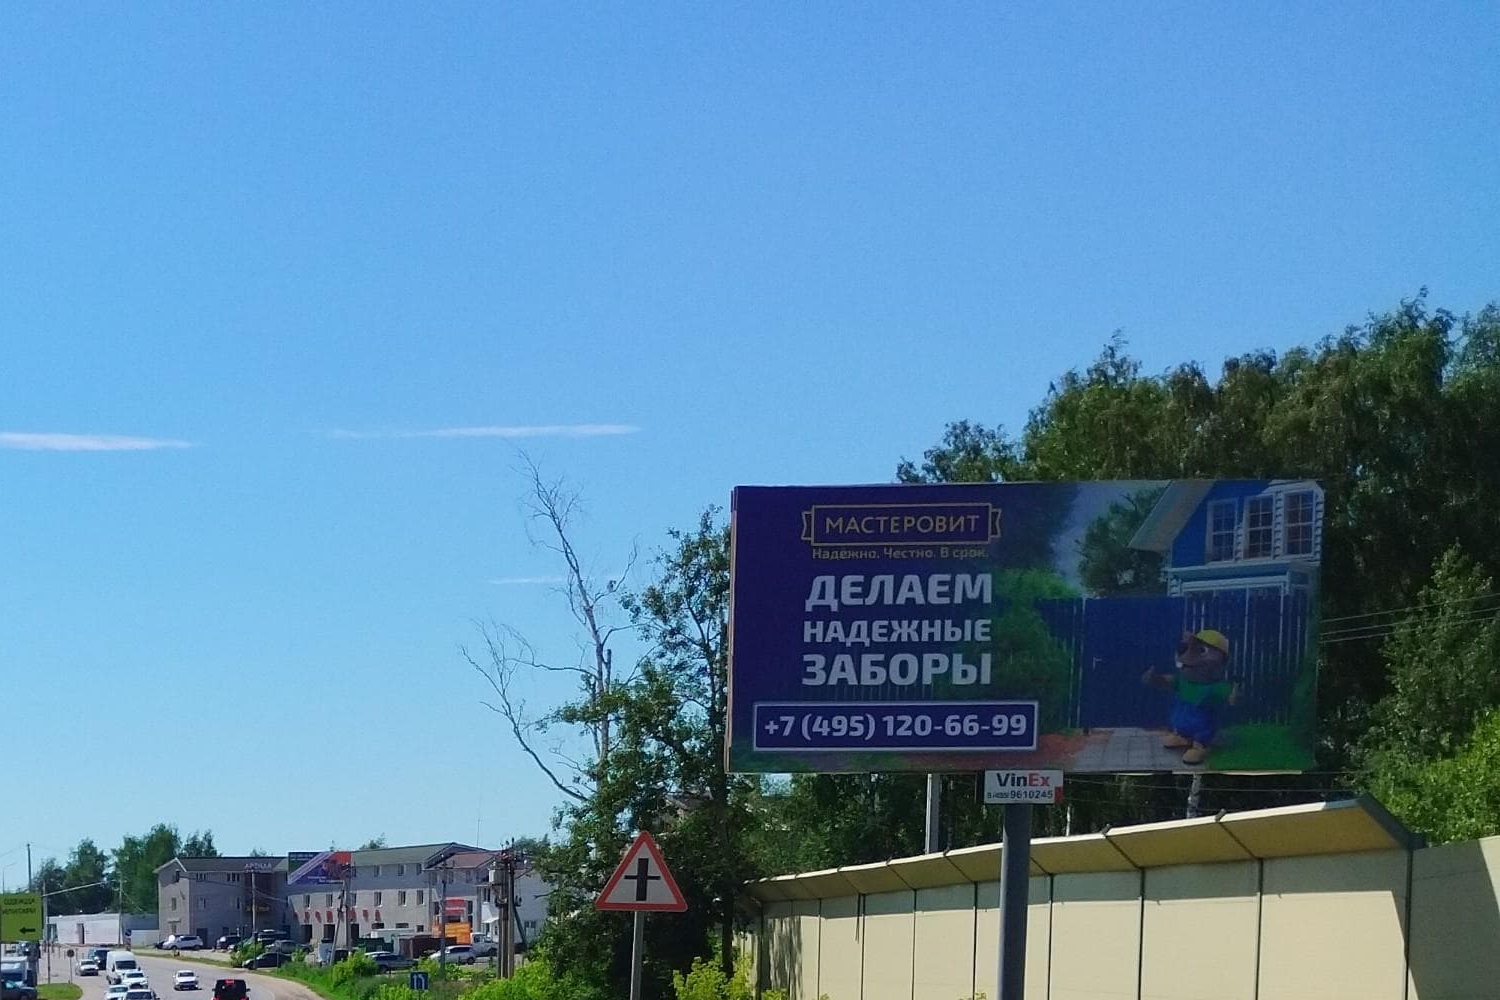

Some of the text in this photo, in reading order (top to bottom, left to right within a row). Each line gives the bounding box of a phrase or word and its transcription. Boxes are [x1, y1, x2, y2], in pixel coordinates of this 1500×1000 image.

[825, 515, 980, 534] МАСТЕРОВИТ
[883, 547, 936, 559] Честно.
[940, 547, 949, 558] В
[953, 548, 989, 560] срок.
[805, 573, 992, 612] ДЕЛАЕМ
[803, 619, 992, 647] НАДЕЖНЫЕ
[802, 653, 992, 686] ЗАБОРЫ
[764, 713, 1027, 741] +7 (495) 120-66-99
[996, 773, 1050, 787] VinEx
